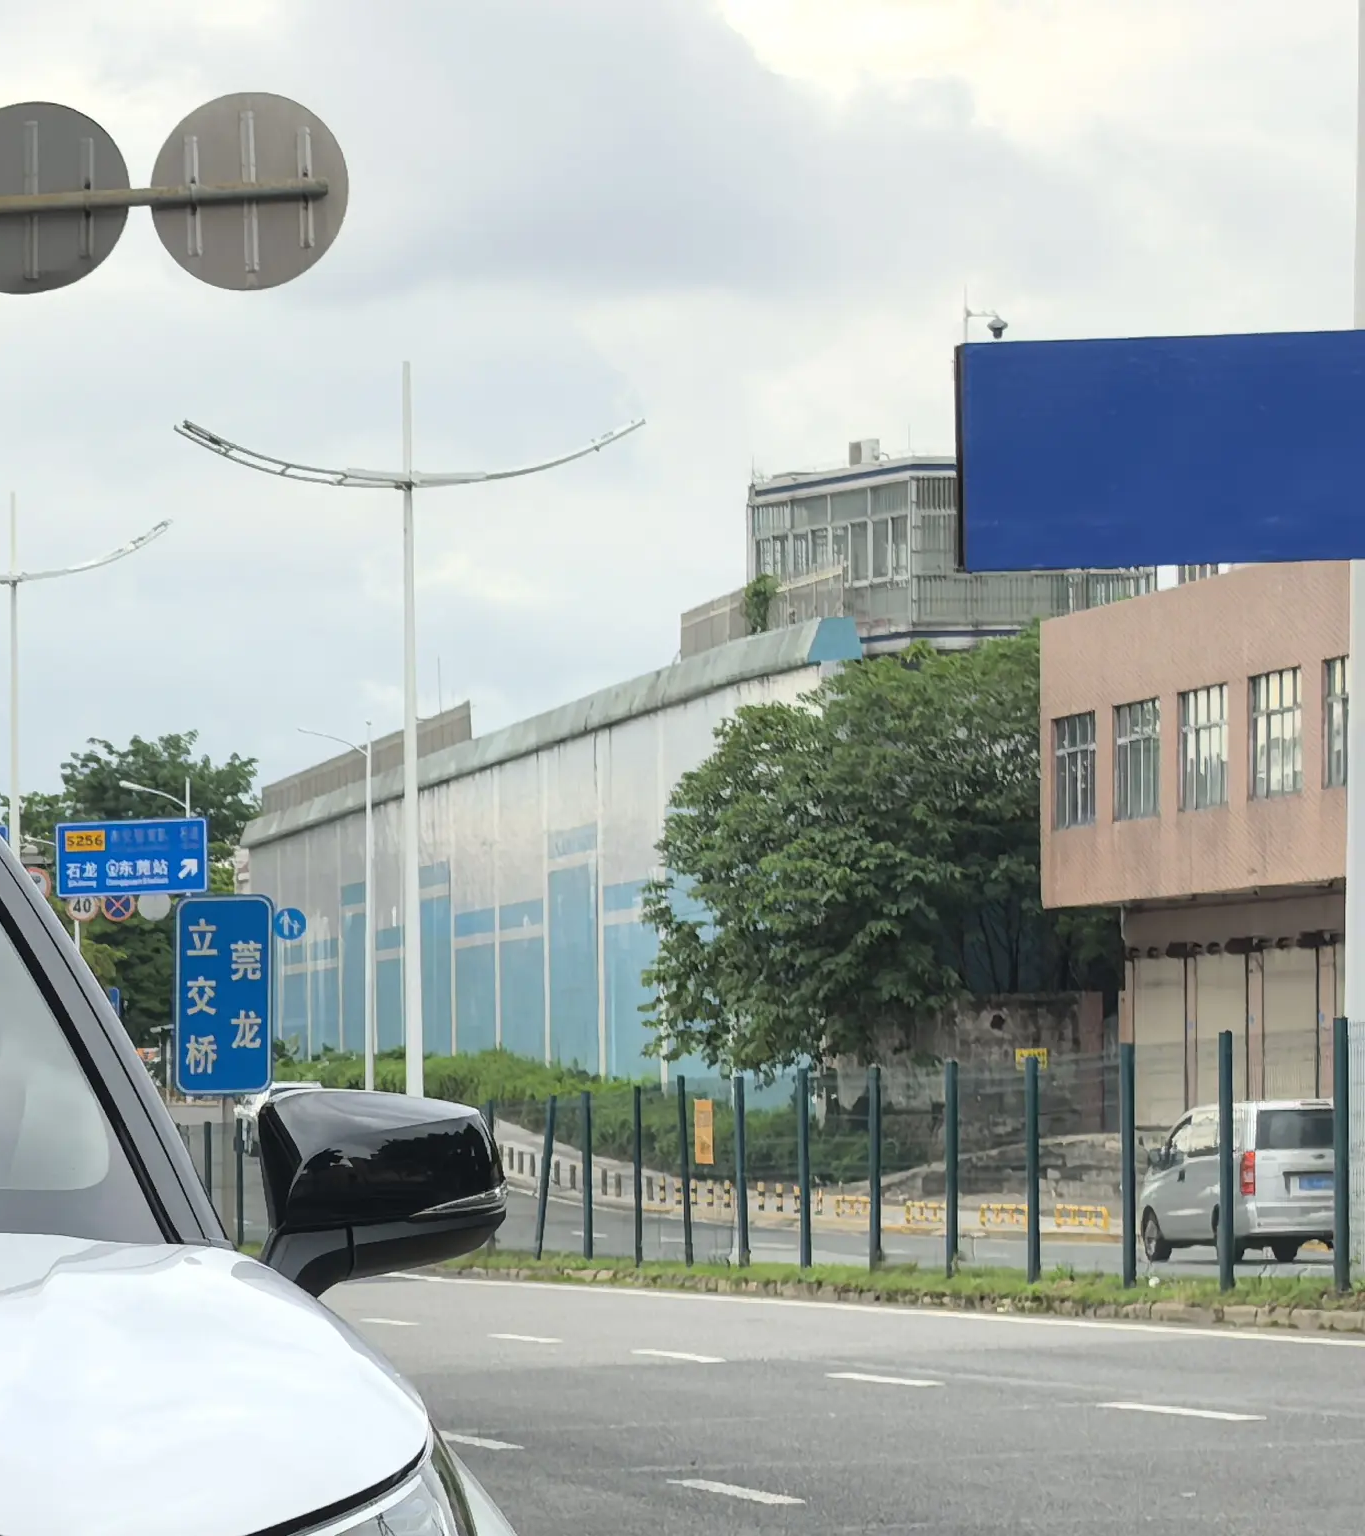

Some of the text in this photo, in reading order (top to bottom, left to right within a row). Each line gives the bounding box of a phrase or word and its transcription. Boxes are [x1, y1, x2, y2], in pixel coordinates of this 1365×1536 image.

[66, 861, 97, 878] 石龙
[73, 898, 91, 913] 40
[185, 918, 218, 1075] 立交桥
[230, 940, 262, 1049] 莞龙
